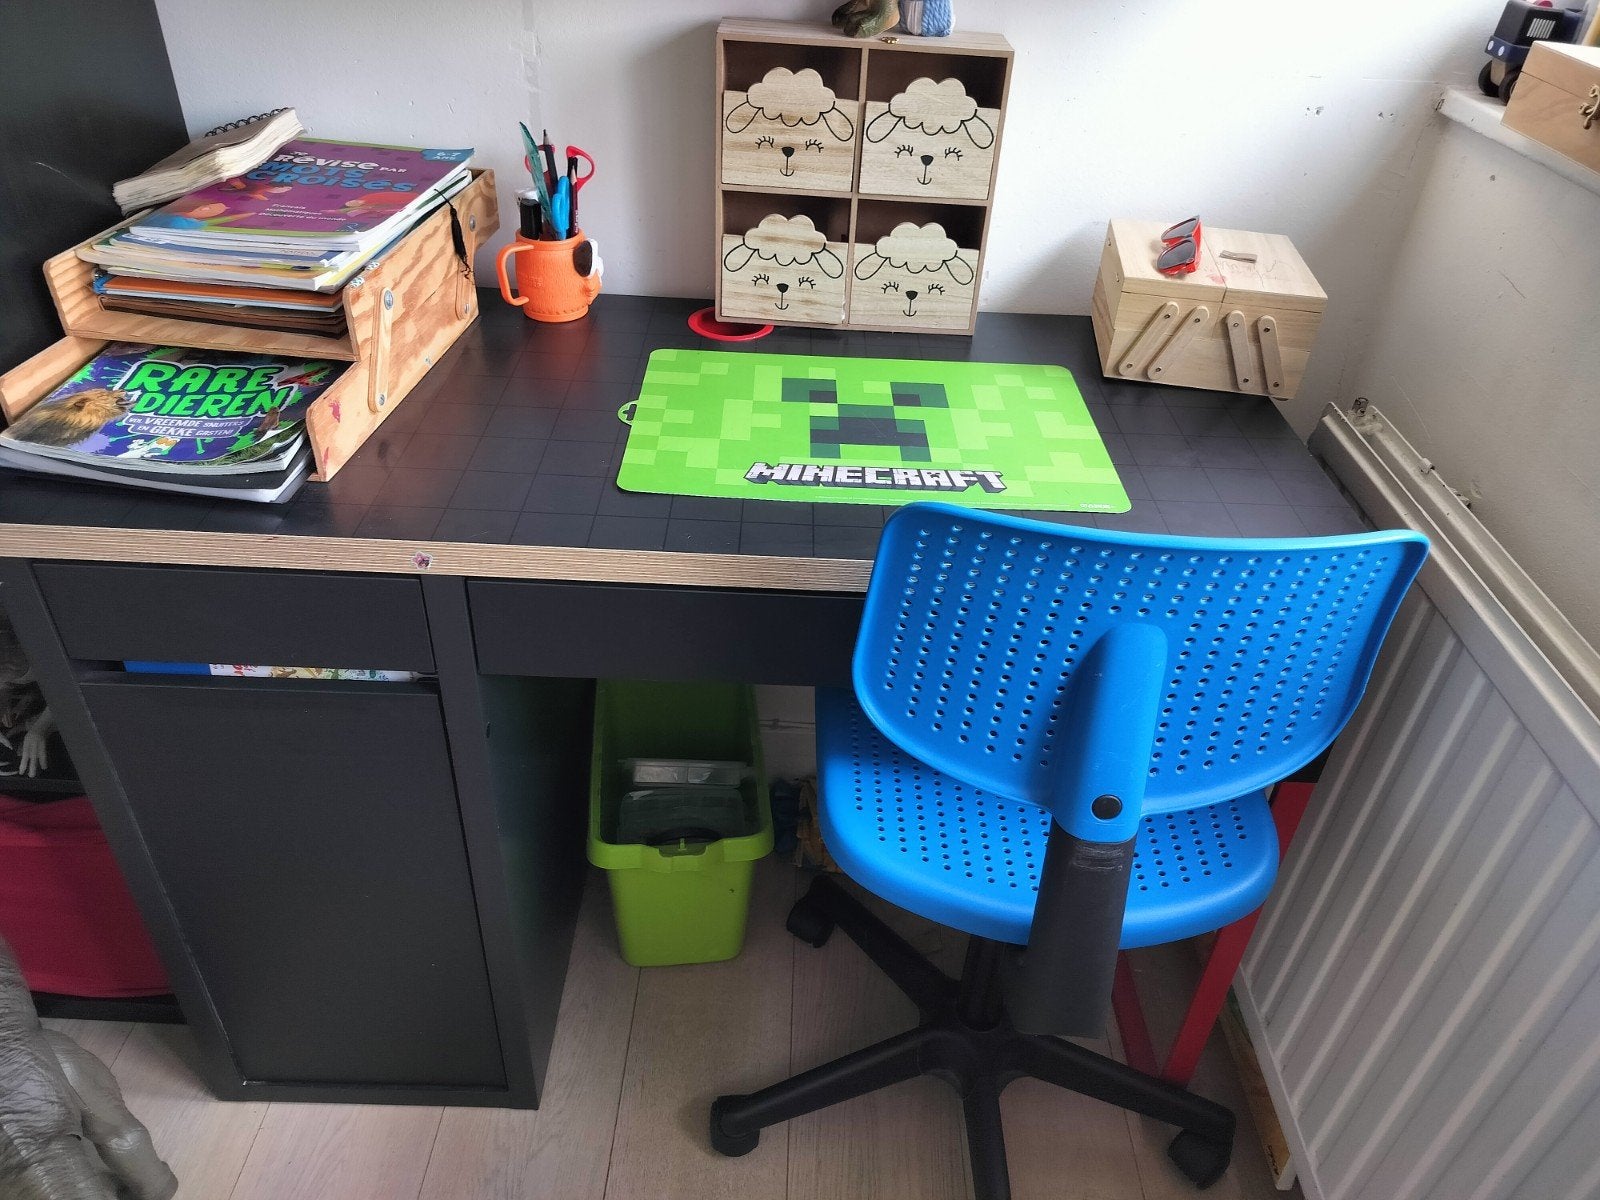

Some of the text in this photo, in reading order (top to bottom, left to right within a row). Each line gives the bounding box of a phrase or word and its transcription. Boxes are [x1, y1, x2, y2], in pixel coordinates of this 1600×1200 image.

[259, 161, 369, 178] MOTS
[127, 363, 274, 392] RARE
[131, 387, 289, 417] DIEREN
[145, 417, 203, 427] VREEMDE
[149, 425, 197, 437] GEKKE
[743, 461, 1008, 493] MINECRAFT
